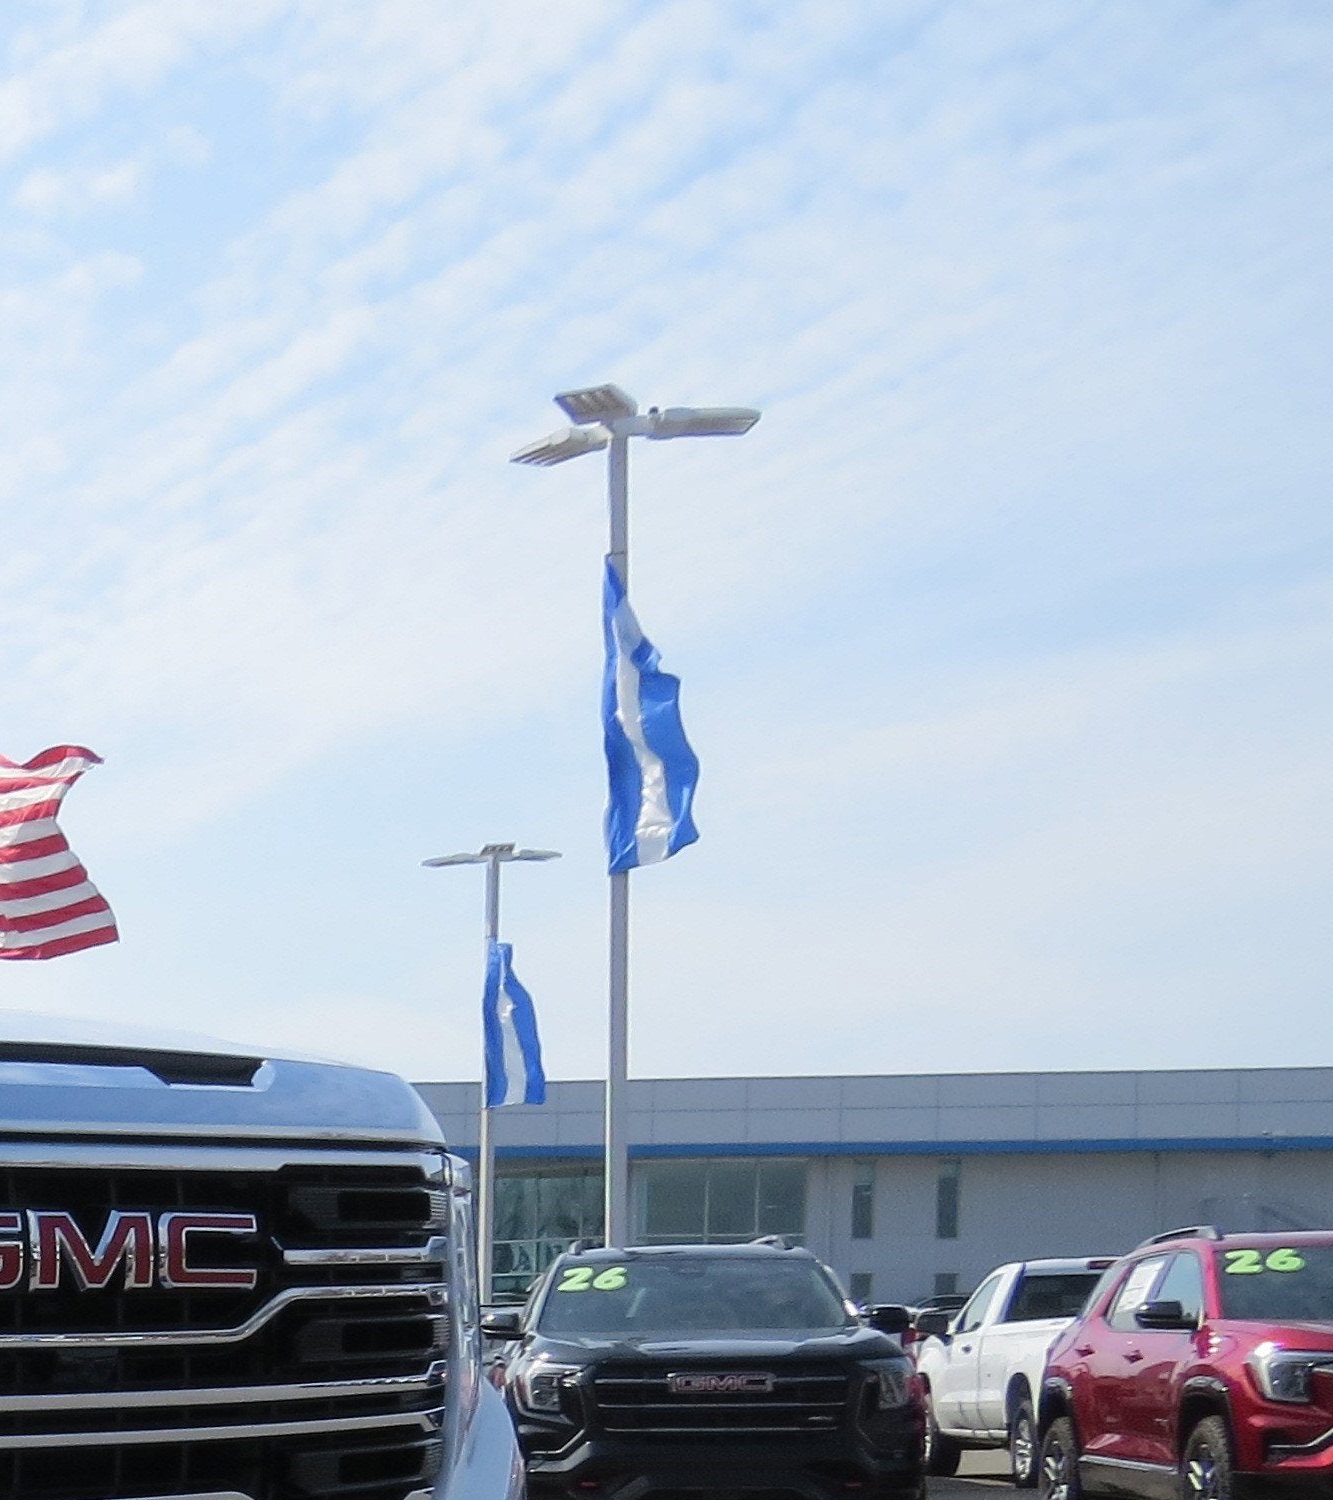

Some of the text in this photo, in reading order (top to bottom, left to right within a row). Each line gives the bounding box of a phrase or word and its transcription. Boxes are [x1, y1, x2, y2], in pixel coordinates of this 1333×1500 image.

[1224, 1247, 1305, 1275] 26
[556, 1266, 628, 1292] 26
[675, 1375, 768, 1391] GMC
